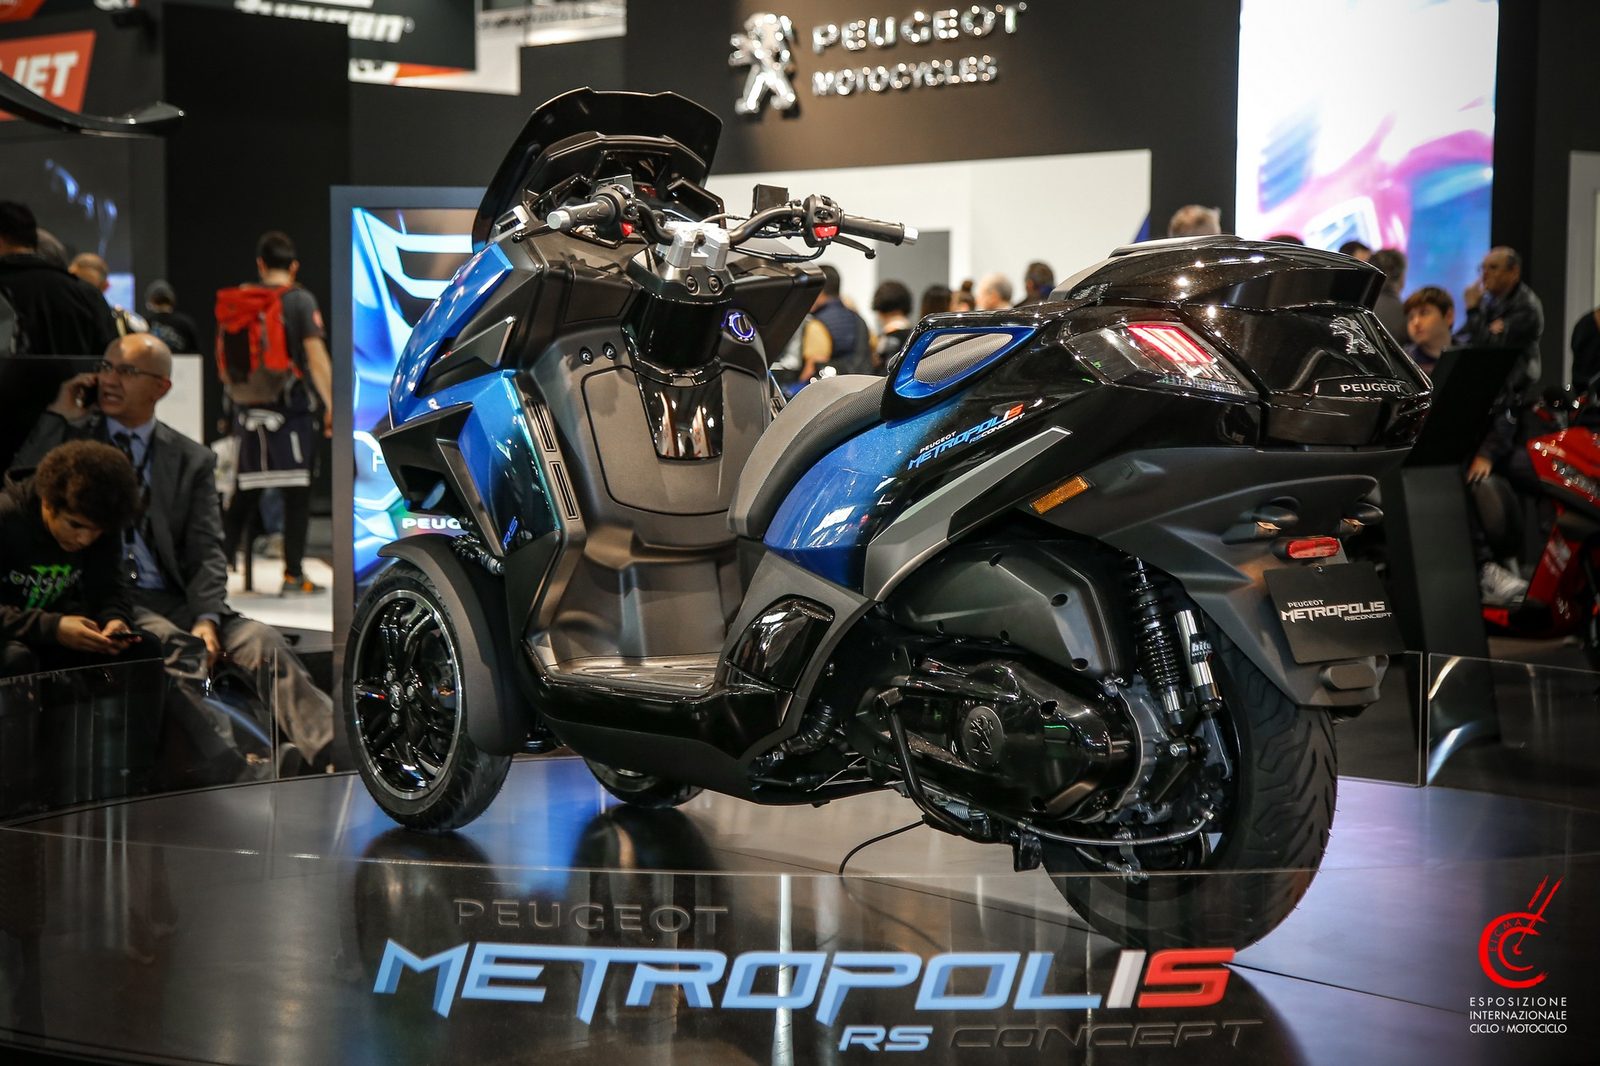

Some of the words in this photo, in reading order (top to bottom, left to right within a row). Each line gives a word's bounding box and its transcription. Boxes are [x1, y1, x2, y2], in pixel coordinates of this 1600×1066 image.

[812, 1, 1028, 55] PEUGEOT
[812, 55, 998, 97] MOTOCYCLES
[1339, 382, 1402, 393] PEUGEOT
[907, 403, 1025, 471] METROPOLIS
[919, 430, 957, 454] PEUGEOT
[1280, 601, 1386, 624] METROPOLIS
[1287, 599, 1324, 608] PEUGEOT
[453, 898, 729, 935] PEUGEOT
[372, 938, 1236, 1027] METROPOLIS
[838, 1024, 934, 1052] RS
[949, 1019, 1265, 1051] CONCEPT
